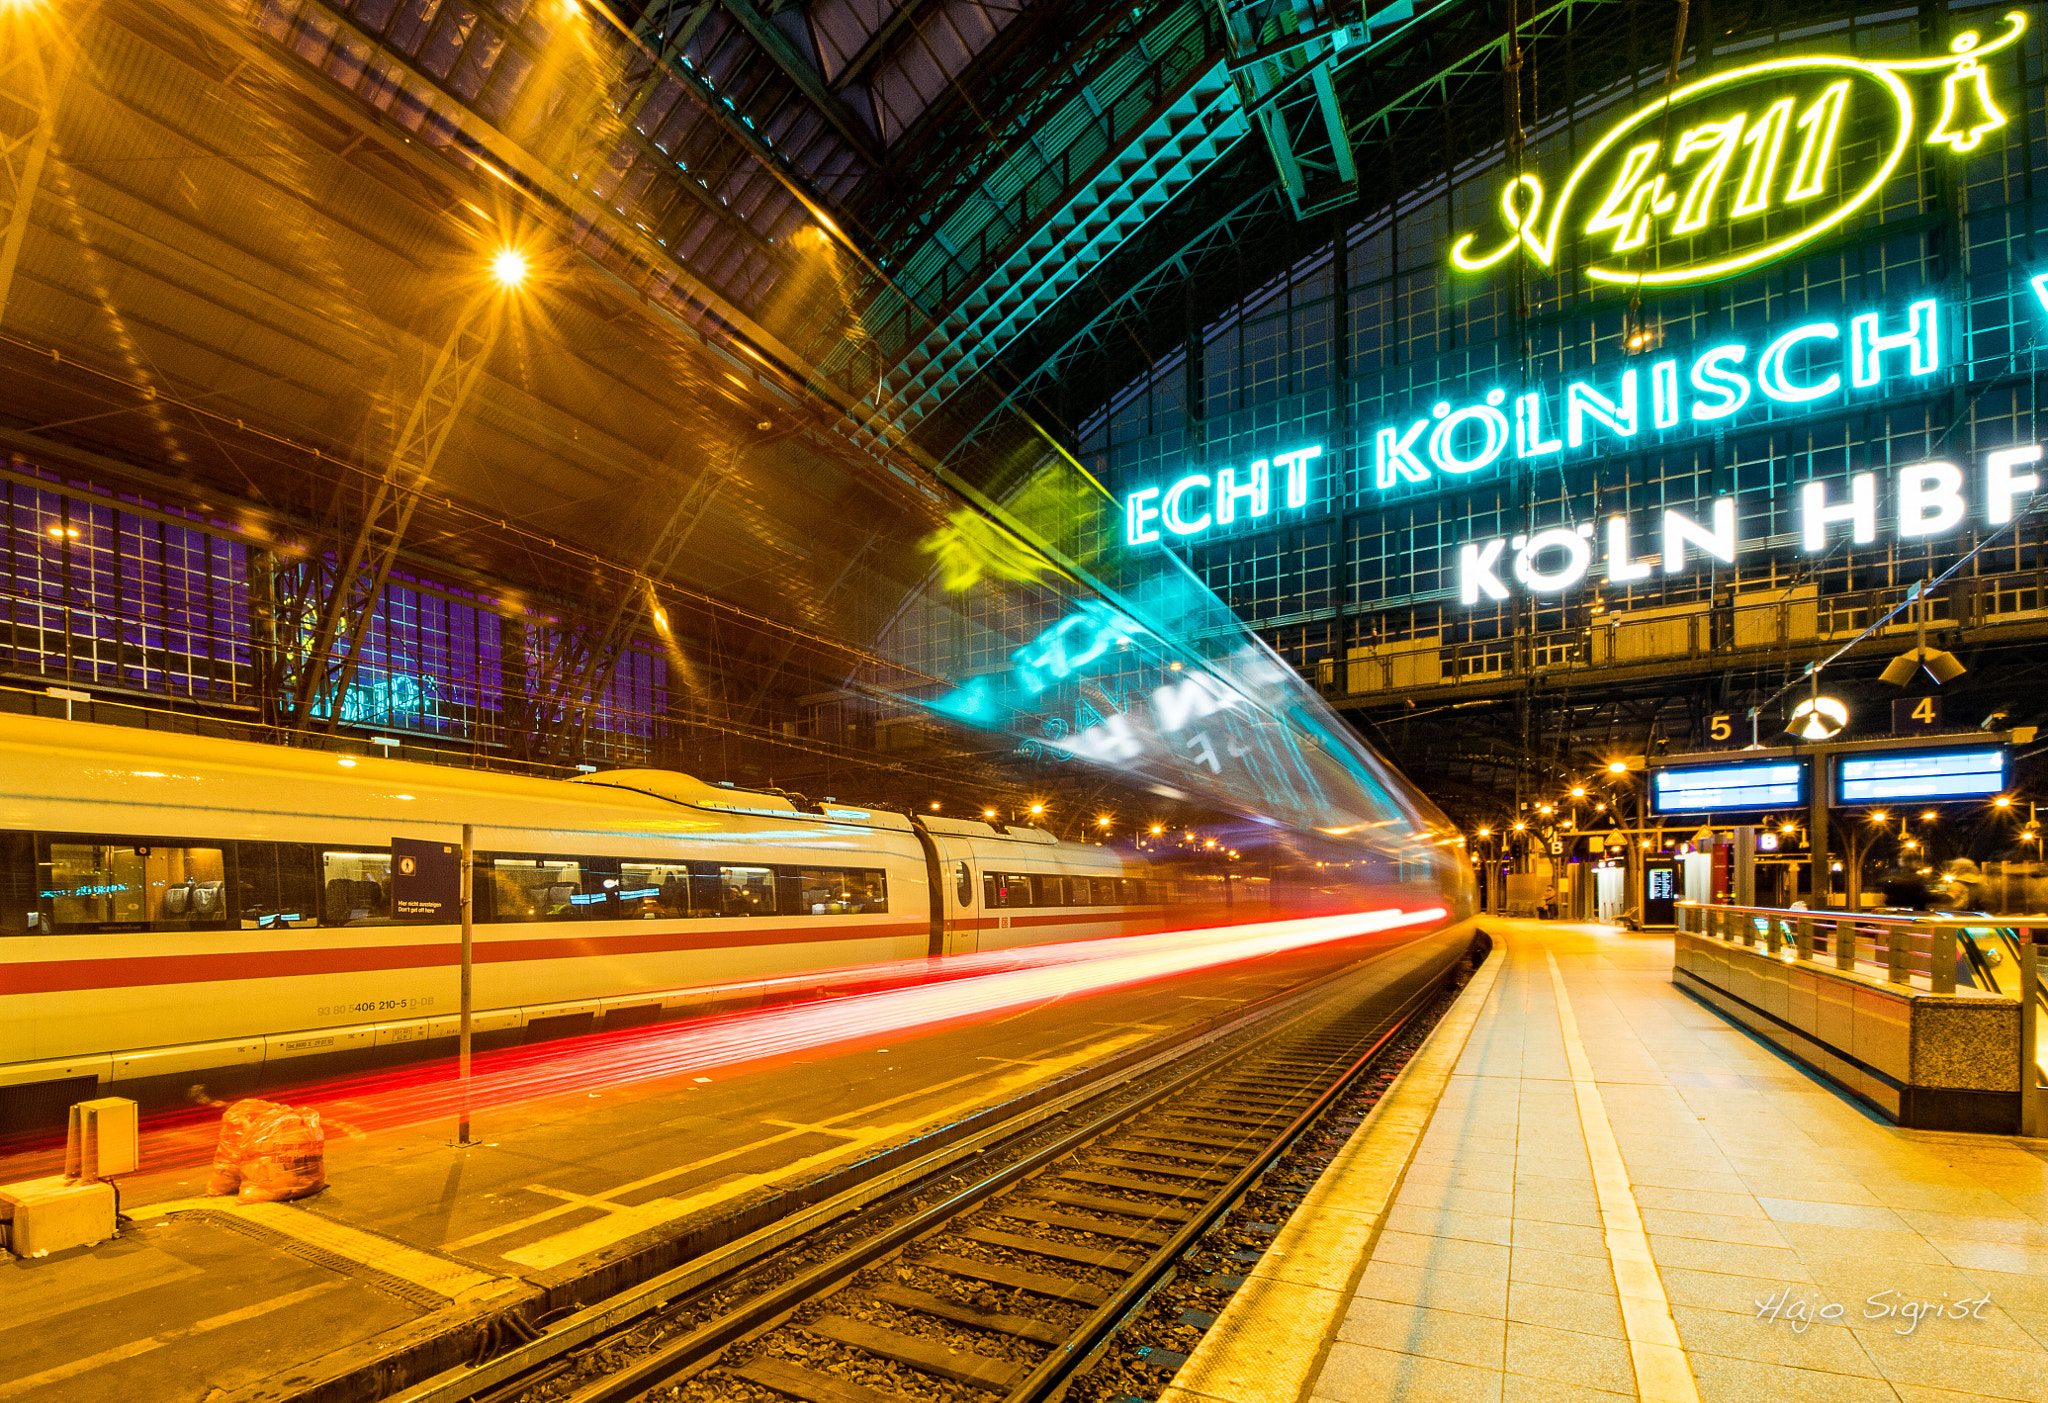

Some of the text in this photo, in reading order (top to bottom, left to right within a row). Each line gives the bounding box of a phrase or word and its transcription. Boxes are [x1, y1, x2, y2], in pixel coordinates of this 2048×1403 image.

[1586, 79, 1850, 253] 4711
[1126, 297, 1941, 546] ECHT KÖLNISCH
[1460, 443, 2045, 606] KÖLN HBF
[1910, 697, 1937, 724] 4
[1709, 714, 1733, 741] 5
[1551, 841, 1563, 855] B
[1761, 834, 1778, 850] B
[317, 1006, 331, 1016] 93
[333, 1005, 346, 1015] 80
[378, 999, 407, 1010] 210-5
[409, 997, 434, 1010] D-DB
